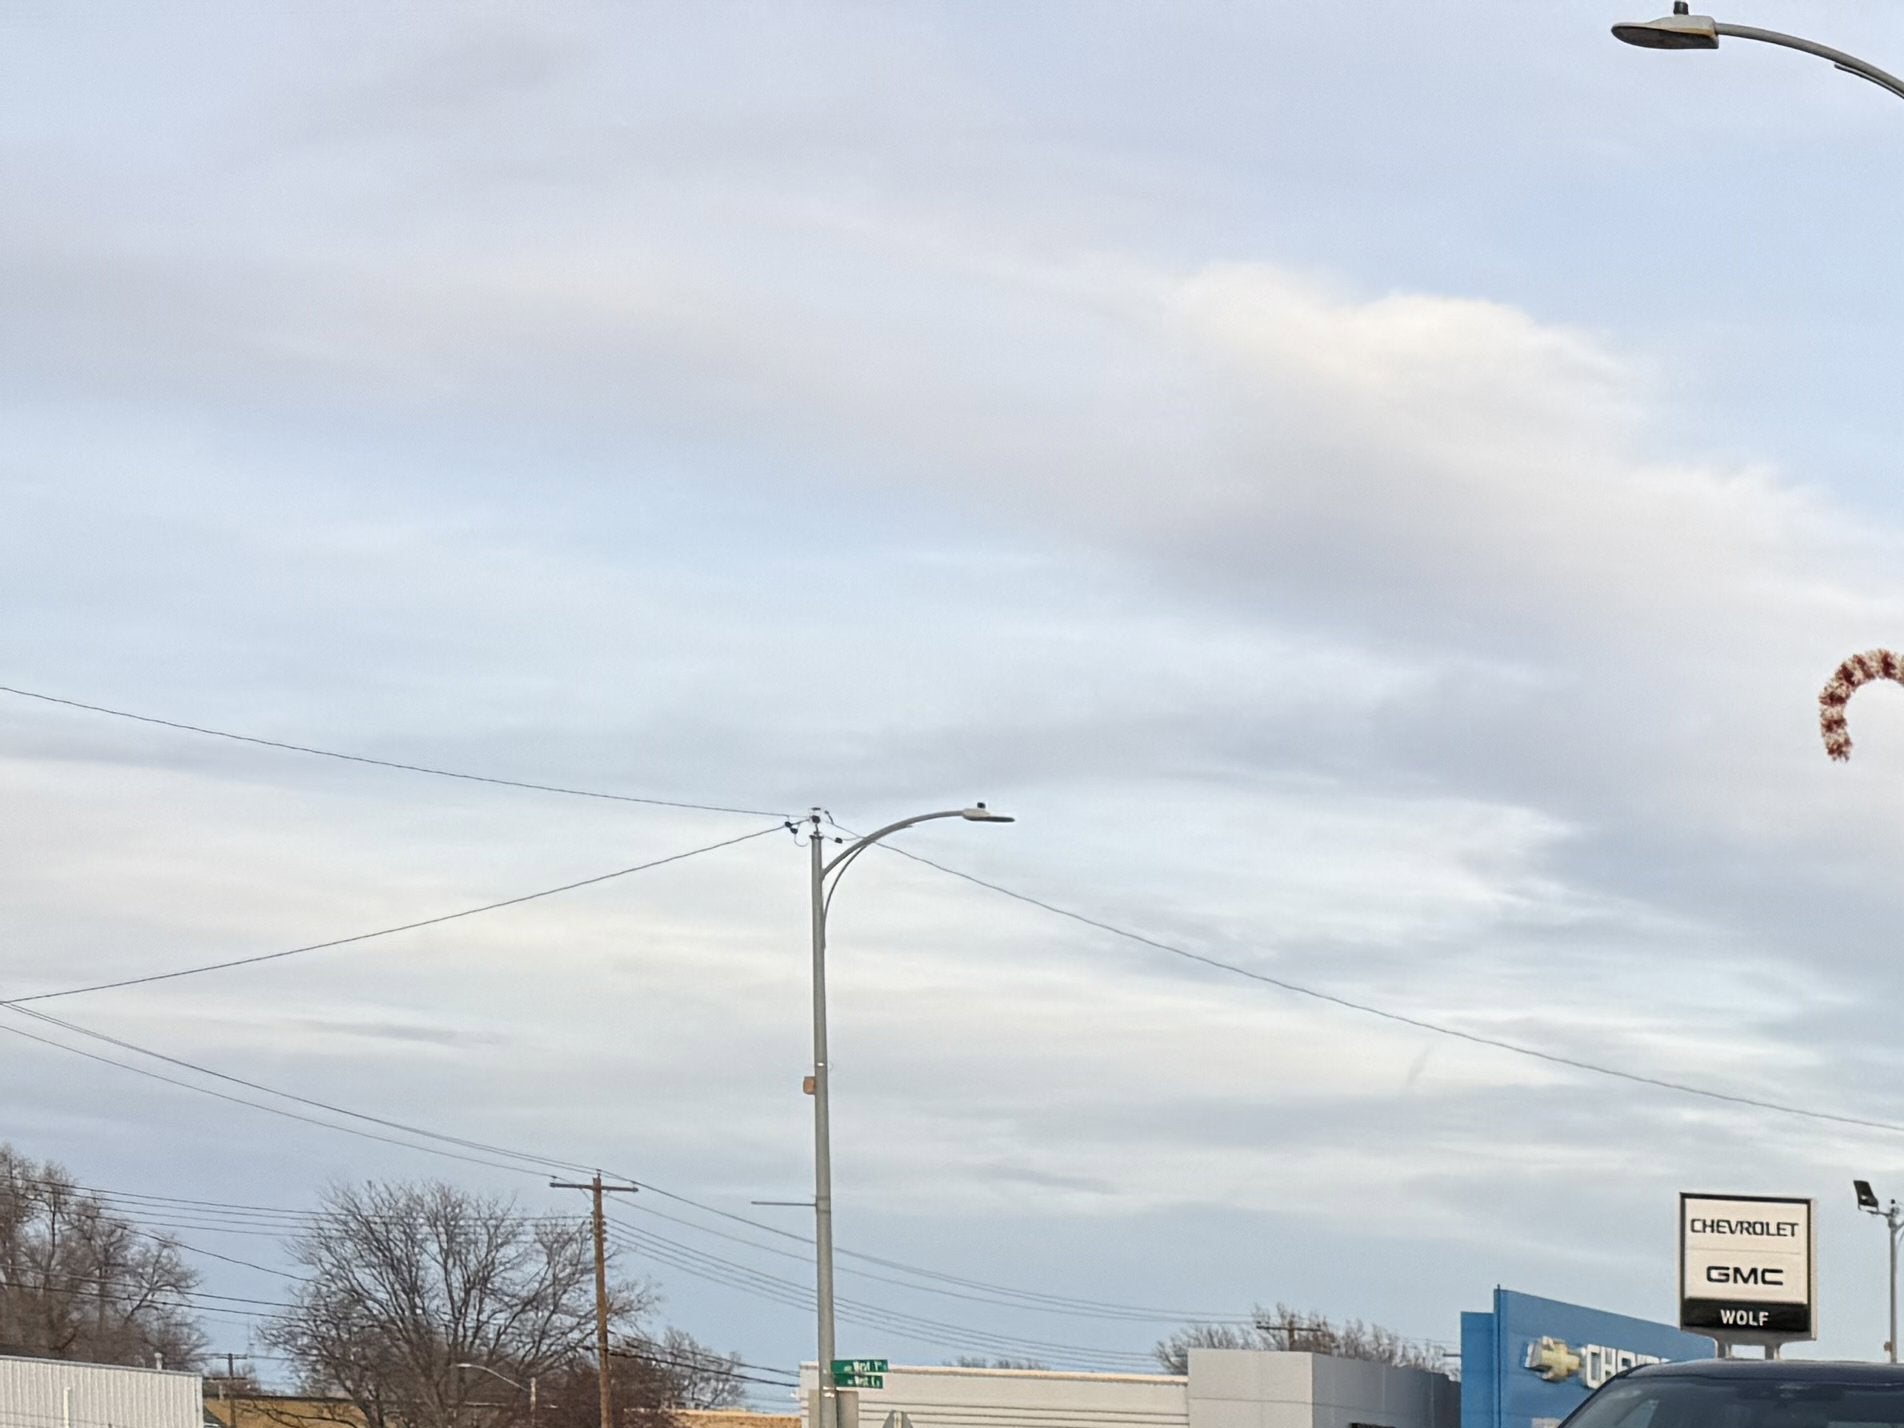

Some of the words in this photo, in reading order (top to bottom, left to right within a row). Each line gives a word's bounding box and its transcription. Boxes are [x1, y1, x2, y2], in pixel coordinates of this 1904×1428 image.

[1690, 1218, 1799, 1237] CHEVROLET
[1706, 1265, 1783, 1286] GMC
[1720, 1309, 1769, 1326] WOLF
